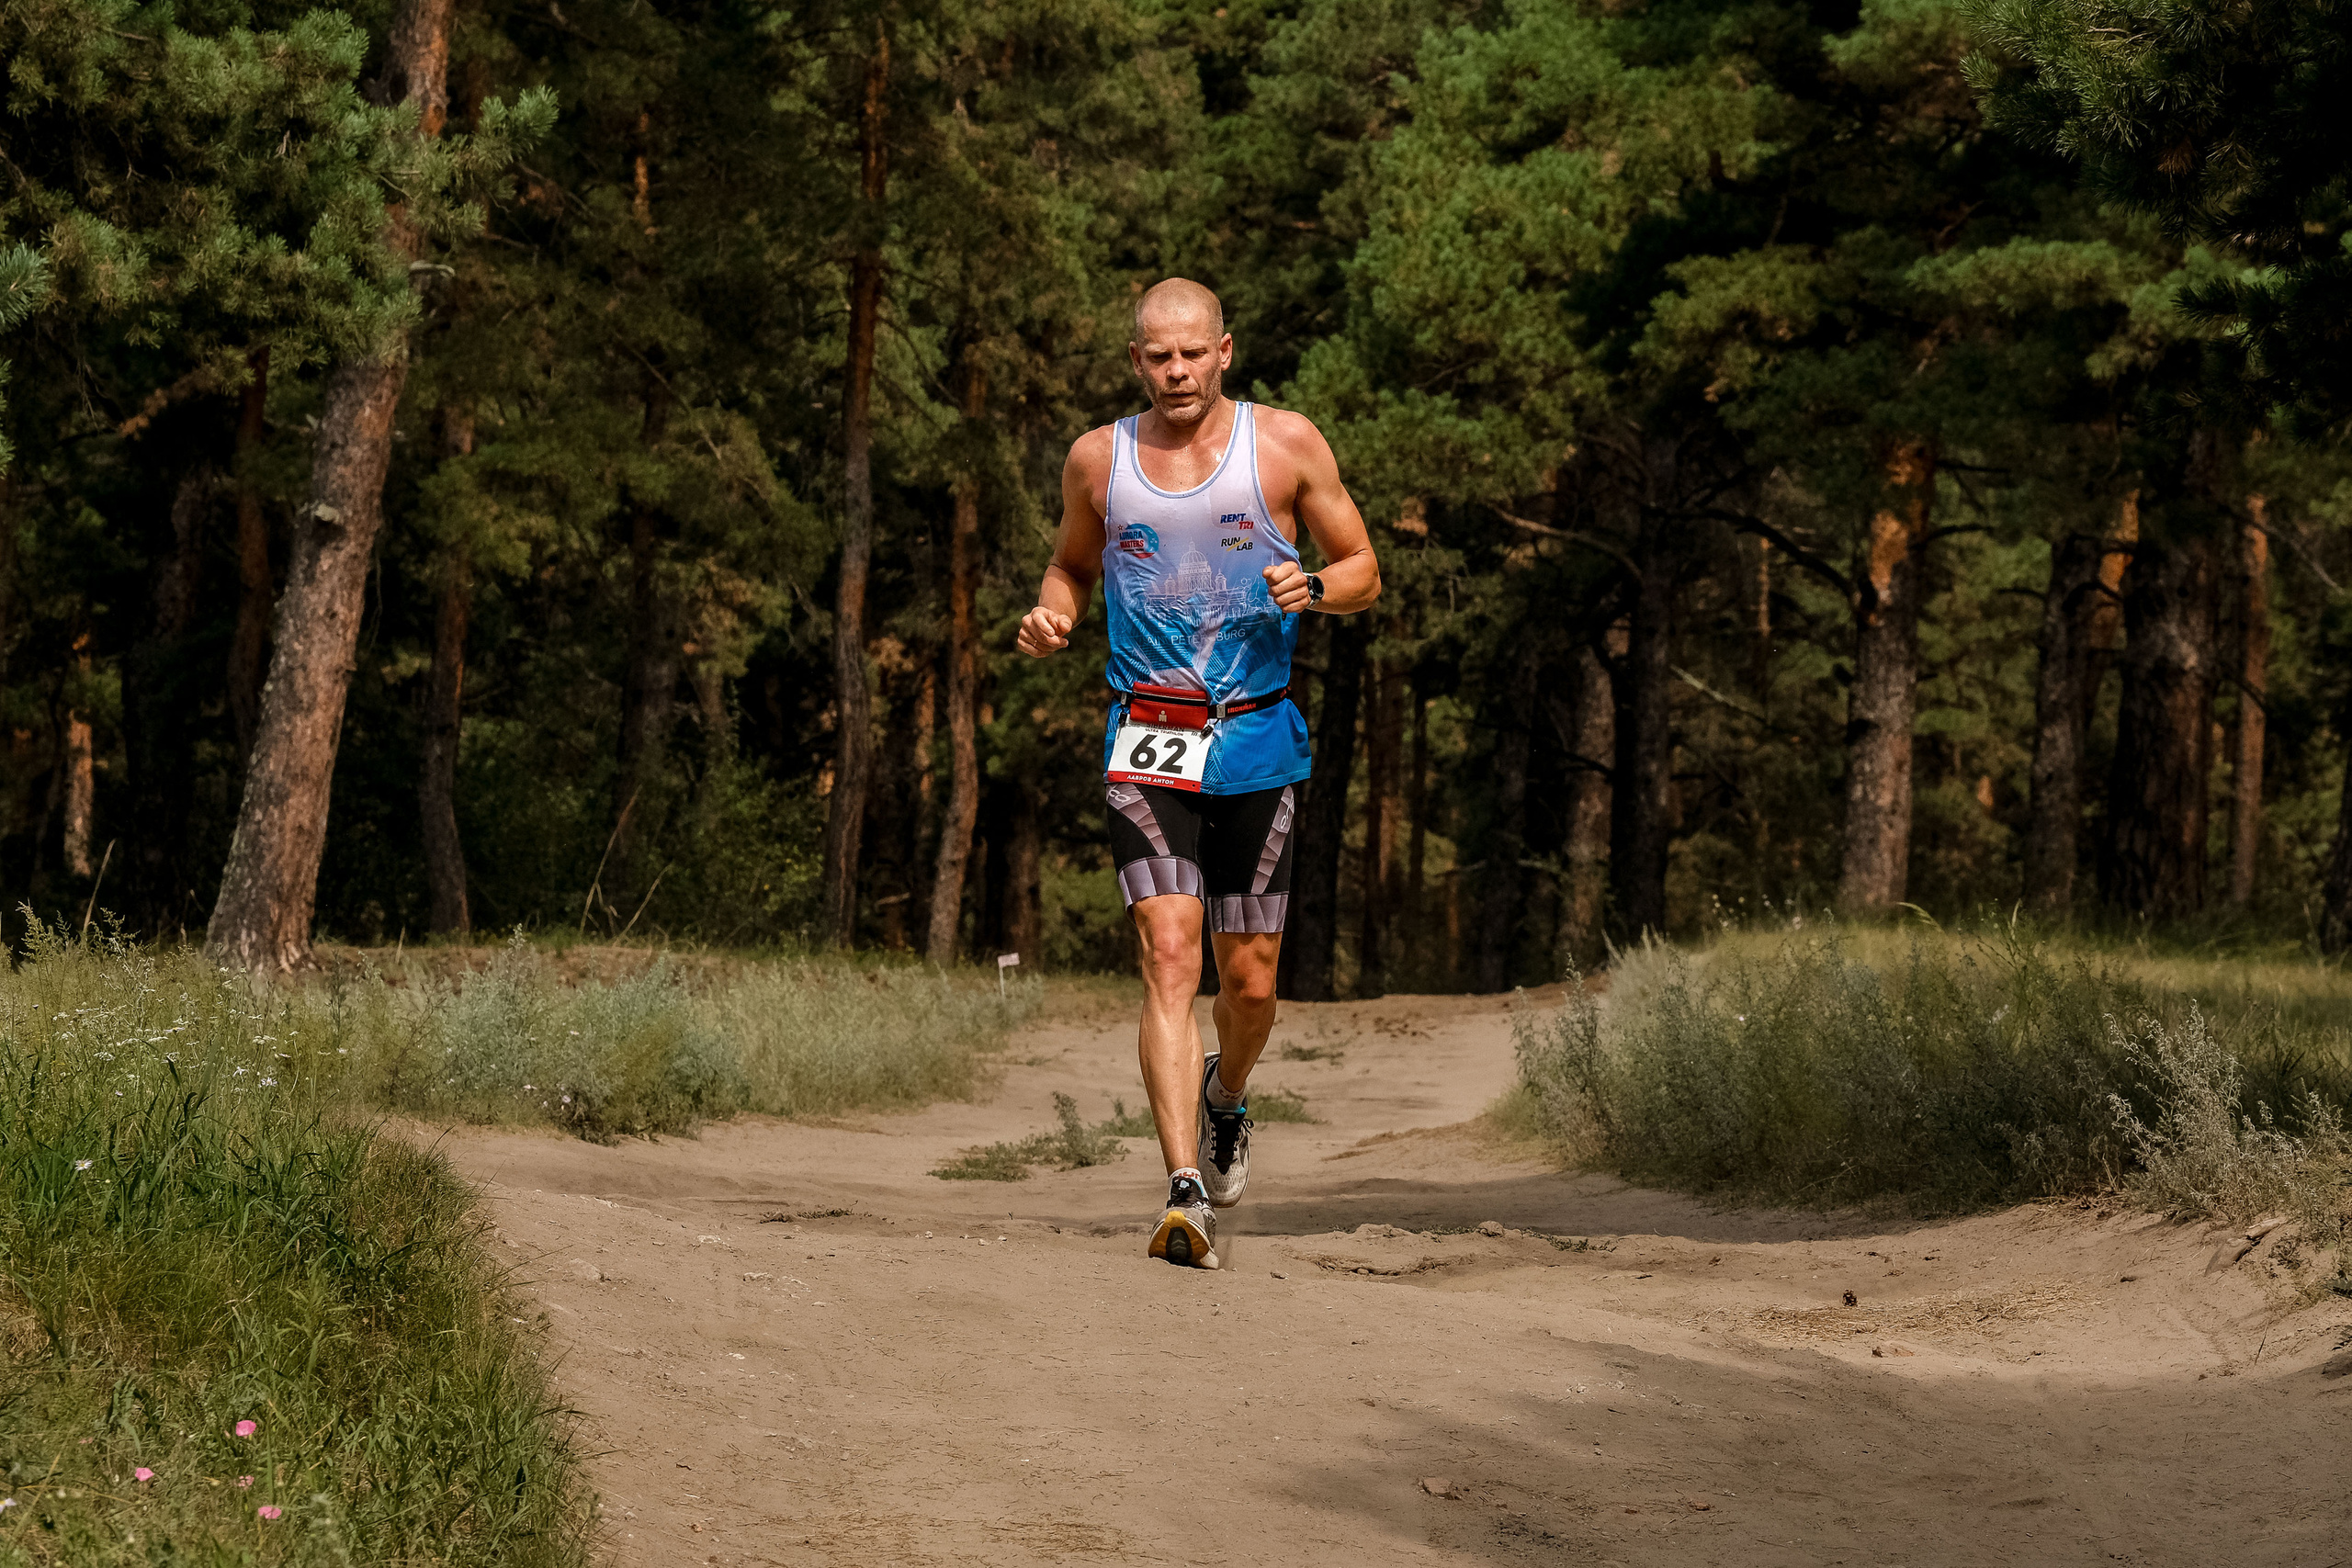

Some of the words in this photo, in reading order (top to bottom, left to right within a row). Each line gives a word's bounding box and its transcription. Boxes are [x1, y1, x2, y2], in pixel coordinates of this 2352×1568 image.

[1220, 513, 1246, 524] RENT
[1238, 521, 1254, 530] TRI
[1221, 536, 1240, 547] RUN
[1237, 541, 1253, 551] LAB
[1129, 733, 1187, 774] 62
